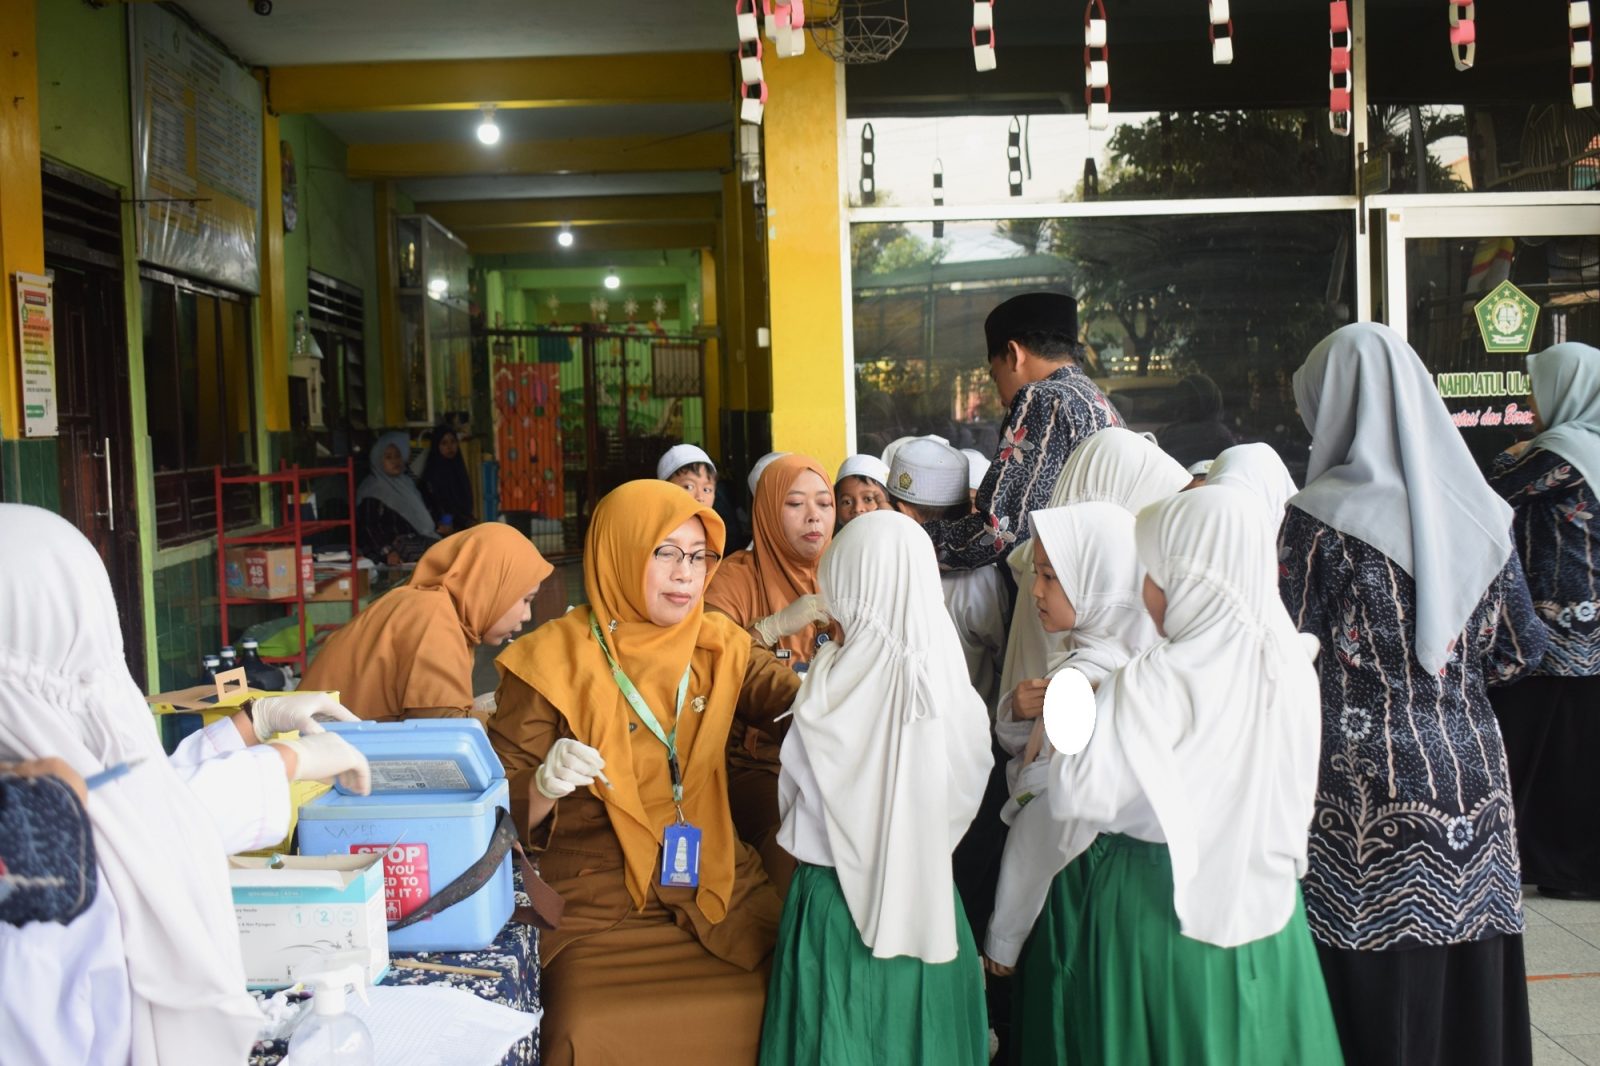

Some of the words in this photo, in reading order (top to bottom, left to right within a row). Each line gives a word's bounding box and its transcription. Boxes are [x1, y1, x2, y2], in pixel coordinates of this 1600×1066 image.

[1437, 372, 1507, 398] NAHDLATUL
[1506, 371, 1532, 396] ULA
[1480, 406, 1502, 426] dan
[249, 565, 264, 577] 48
[387, 865, 415, 874] YOU
[401, 876, 419, 886] TO
[399, 888, 413, 898] IT
[319, 910, 330, 922] 2
